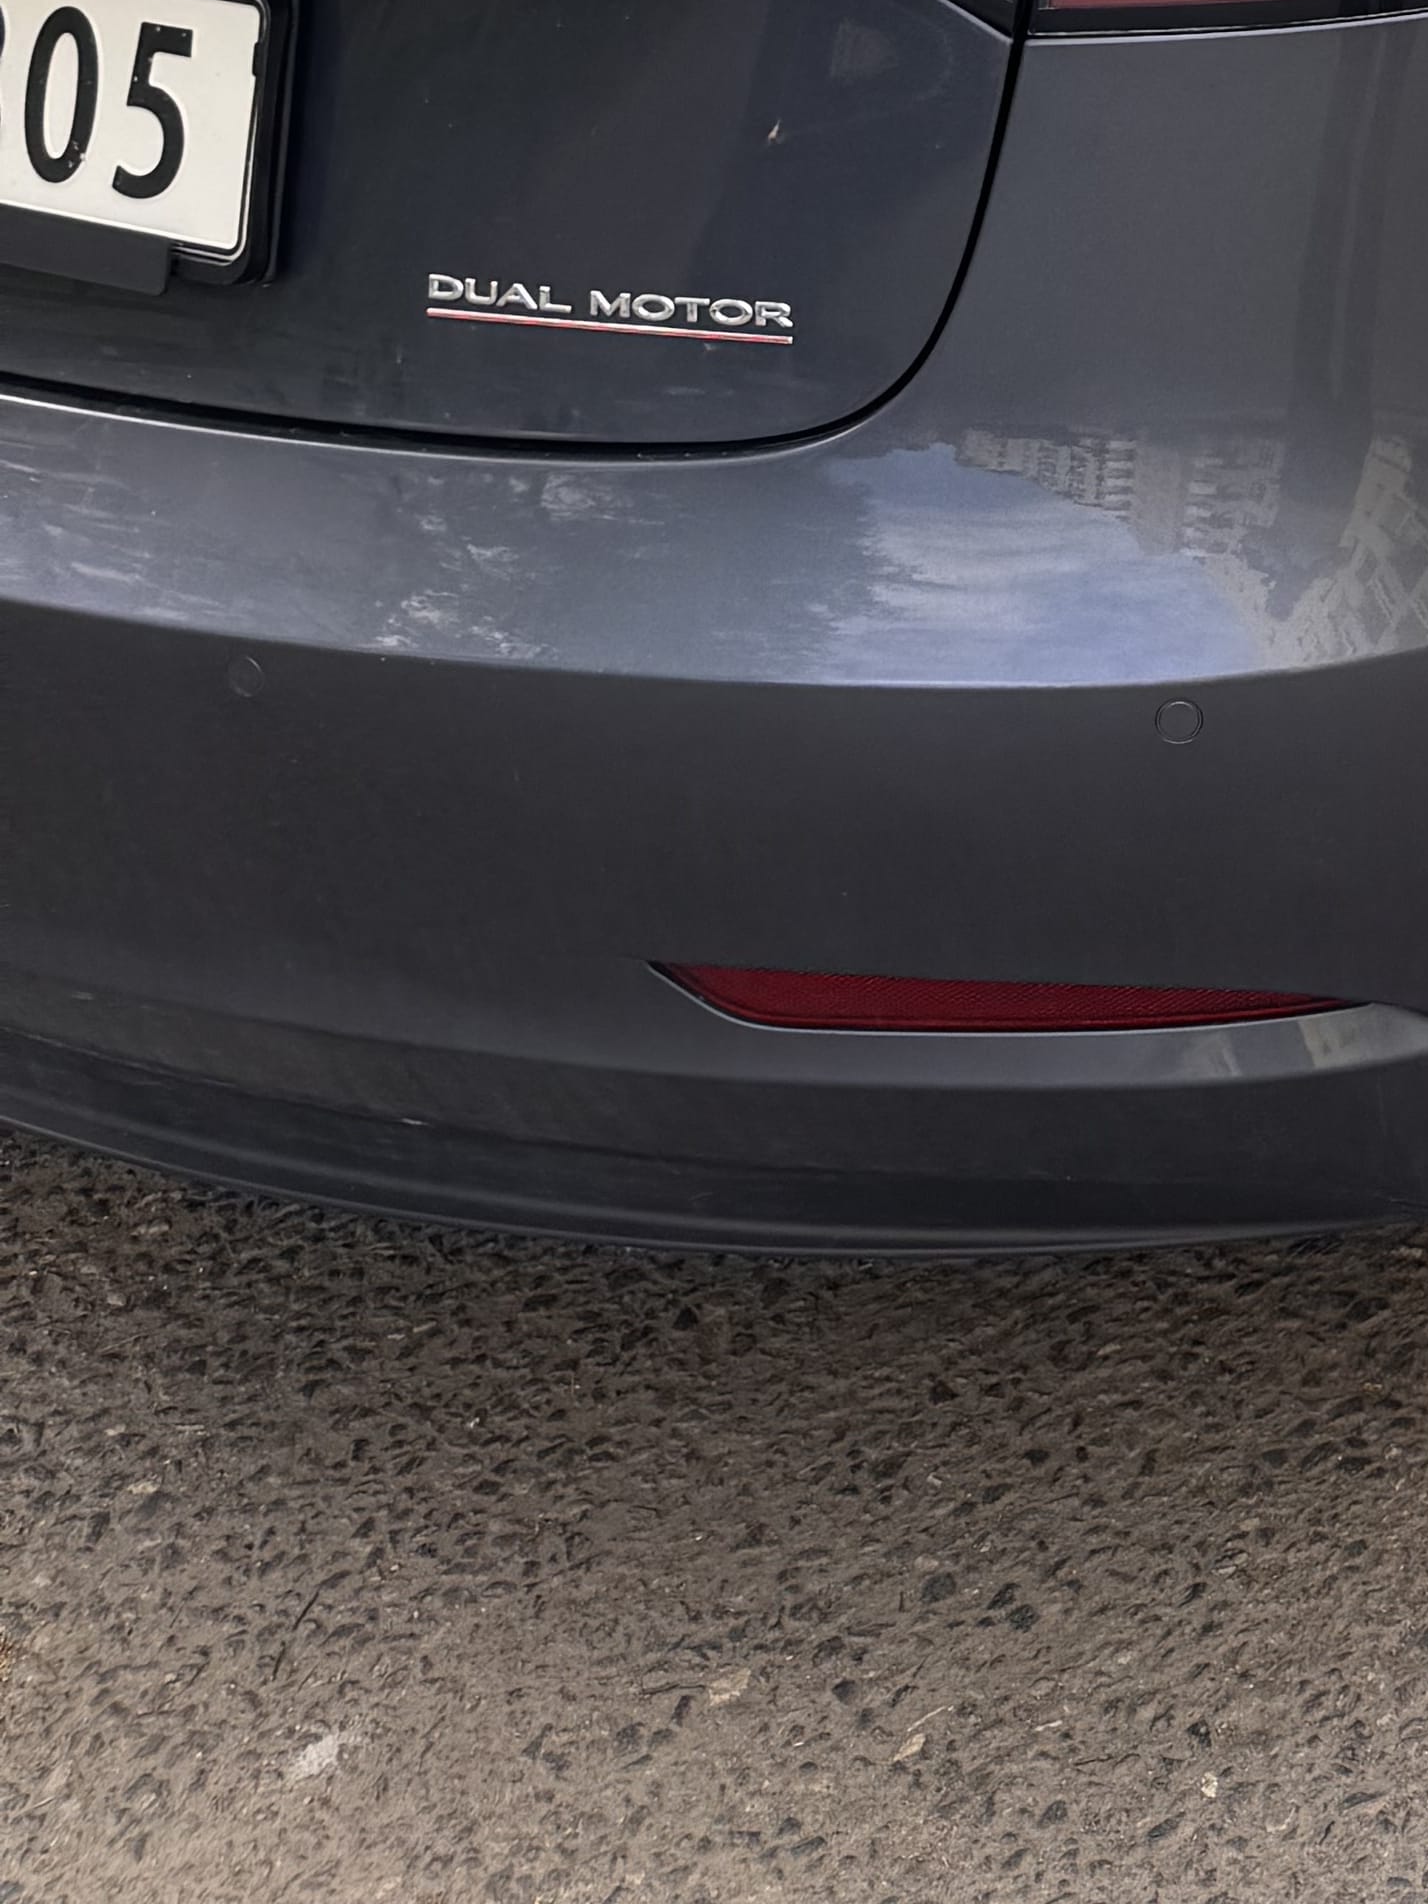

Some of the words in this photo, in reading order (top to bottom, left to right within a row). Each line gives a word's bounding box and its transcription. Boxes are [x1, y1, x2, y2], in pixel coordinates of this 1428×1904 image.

[0, 0, 194, 200] 05
[428, 273, 572, 315] DUAL
[588, 288, 794, 329] MOTOR
